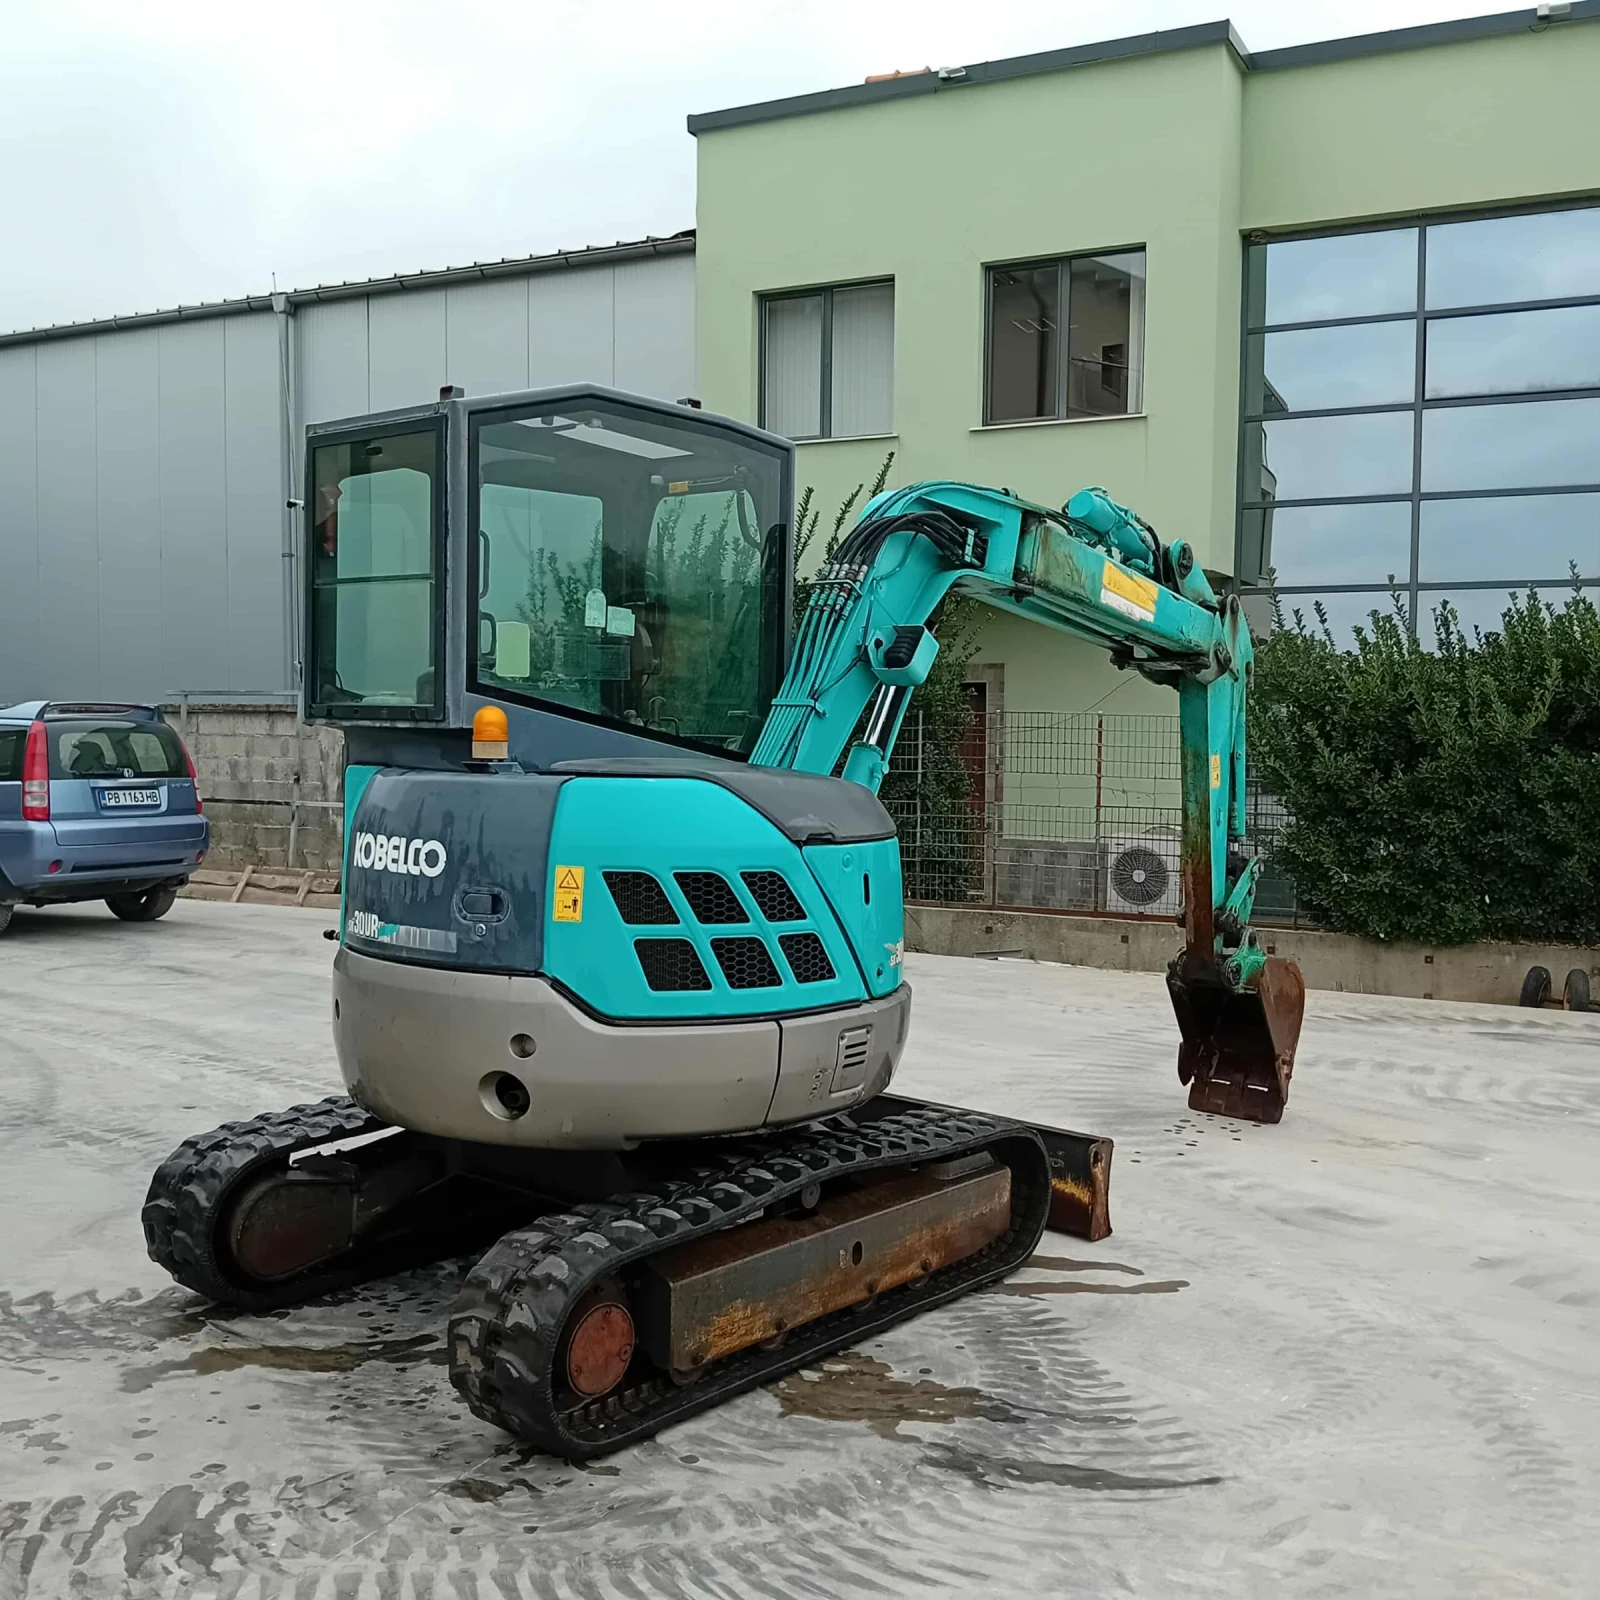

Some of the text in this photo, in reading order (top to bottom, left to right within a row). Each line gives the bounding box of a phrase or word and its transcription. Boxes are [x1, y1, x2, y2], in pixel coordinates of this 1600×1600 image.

[107, 791, 159, 804] PB 1163 HB
[353, 832, 447, 877] KOBELCO
